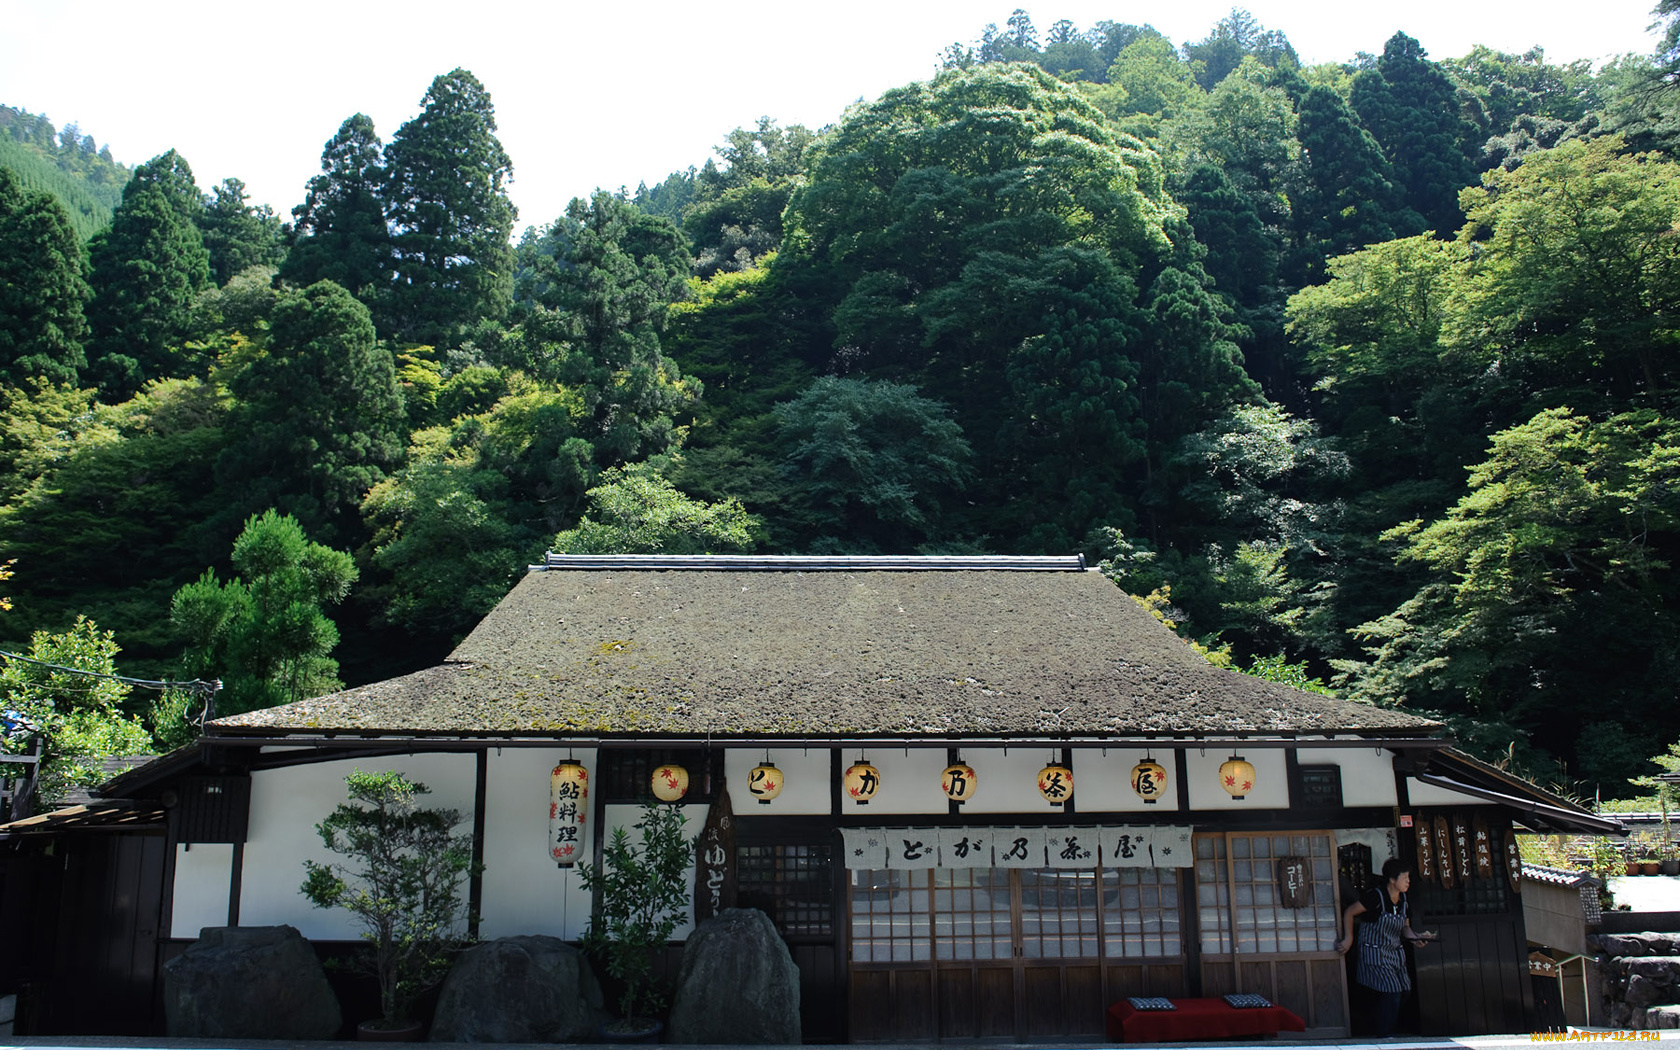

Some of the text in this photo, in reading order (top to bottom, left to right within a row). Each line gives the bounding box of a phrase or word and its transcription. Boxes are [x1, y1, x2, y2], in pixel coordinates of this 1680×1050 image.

[749, 770, 765, 795] と
[1044, 772, 1067, 798] 茶
[556, 780, 580, 843] 鮎料理
[1419, 827, 1431, 876] 山菜うどん
[1437, 828, 1451, 878] にしんそば
[1455, 824, 1470, 877] 松茸うどん
[1476, 831, 1490, 867] 鮎塩焼
[1508, 843, 1520, 882] 営業中
[1286, 865, 1297, 899] コーヒー
